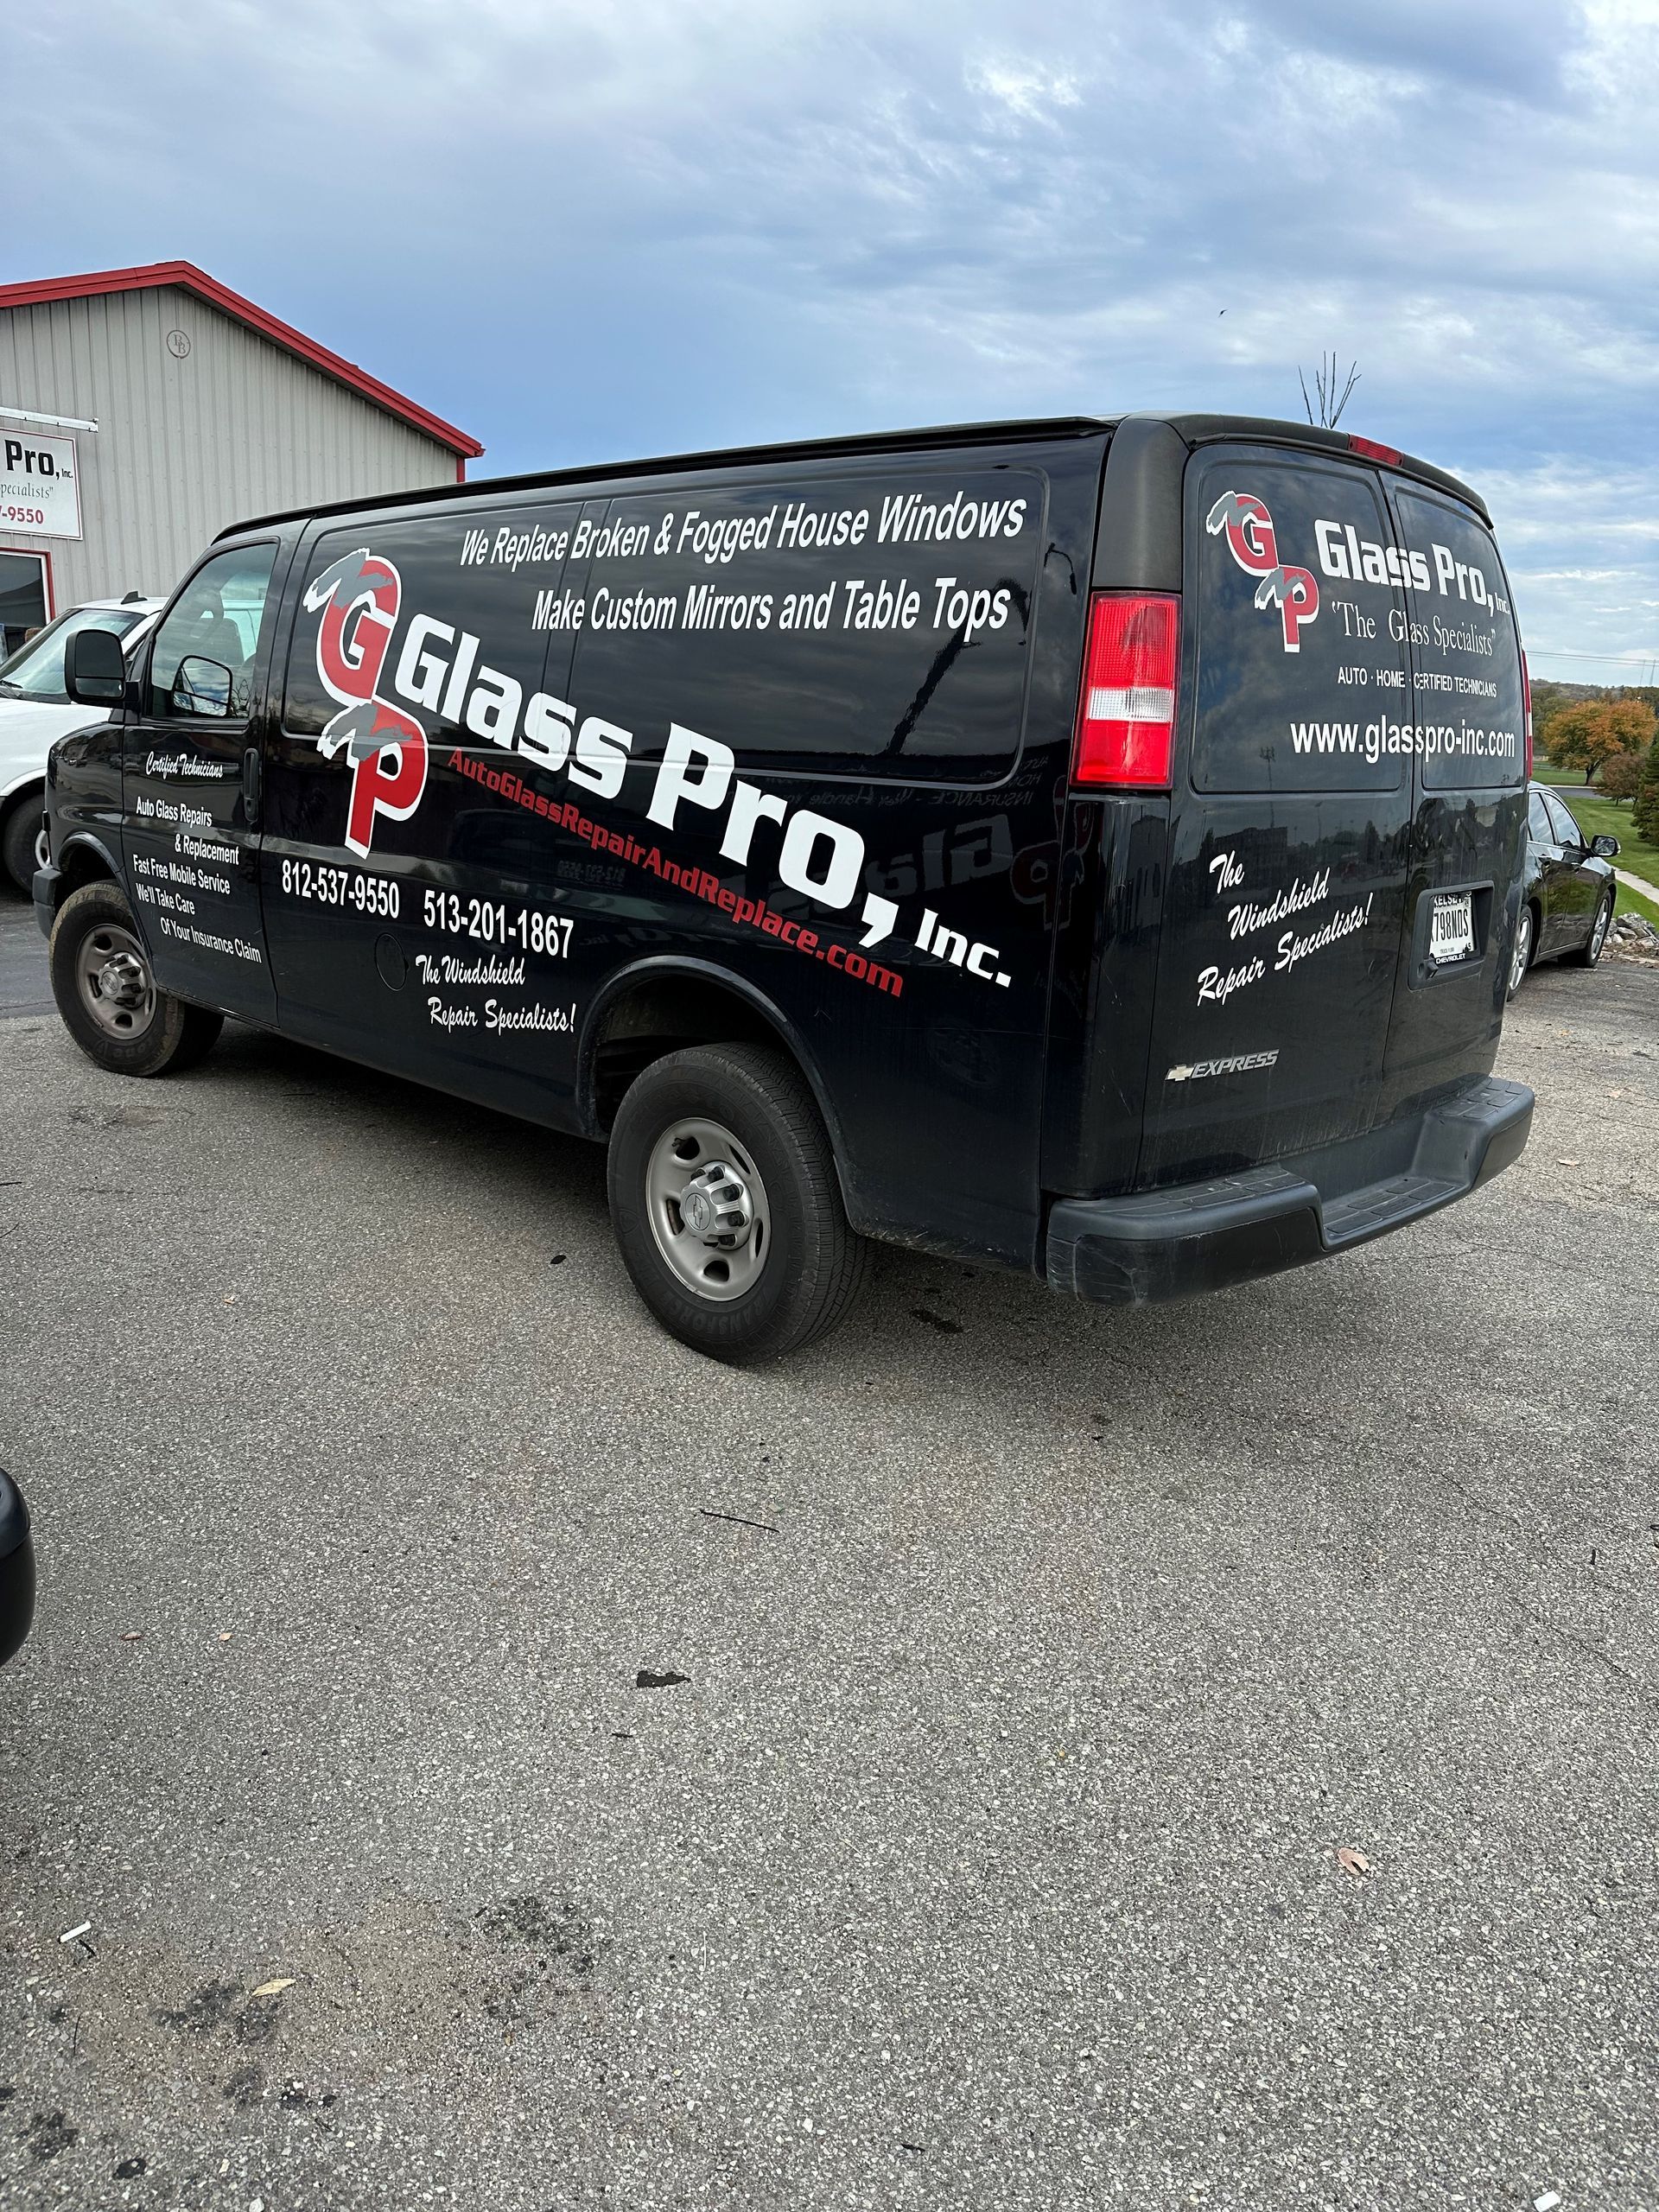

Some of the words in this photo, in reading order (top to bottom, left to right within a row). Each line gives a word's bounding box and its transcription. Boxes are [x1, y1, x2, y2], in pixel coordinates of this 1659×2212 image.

[4, 439, 60, 480] Pro,
[61, 467, 73, 478] Inc.
[0, 482, 54, 499] pecialists"
[0, 505, 44, 524] -9550
[460, 528, 488, 566] We
[490, 524, 569, 572] Replace
[570, 517, 650, 559] Broken
[653, 512, 674, 555] &
[676, 505, 778, 564] Fogged
[777, 502, 869, 549] House
[877, 491, 1027, 543] Windows
[1314, 518, 1431, 592] Glass
[1431, 543, 1494, 617] Pro,
[1496, 592, 1510, 615] Inc.
[531, 588, 585, 630] Make
[590, 587, 677, 630] Custom
[681, 584, 773, 630] Mirrors
[779, 581, 836, 630] and
[842, 578, 921, 630] Table
[932, 577, 1011, 643] Tops
[1389, 608, 1429, 645] Glass
[1338, 666, 1367, 685] AUTO
[1376, 669, 1406, 688] HOME
[1414, 671, 1453, 692] CERTIFIED
[1454, 676, 1497, 698] TECHNICIANS
[1290, 715, 1516, 764] www.glasspro-inc.com
[145, 751, 180, 779] Certified
[179, 753, 224, 778] Technicians
[137, 796, 155, 817] Auto
[156, 799, 179, 822] Glass
[180, 803, 213, 829] Repairs
[394, 613, 633, 799] Glass
[645, 721, 899, 948] Pro,
[914, 908, 1012, 988] Inc.
[175, 833, 181, 852] &
[183, 835, 239, 865] Replacement
[133, 854, 151, 875] Fast
[150, 858, 168, 879] Free
[169, 861, 197, 887] Mobile
[197, 868, 231, 895] Service
[282, 859, 399, 918] 812-537-9550
[448, 747, 904, 997] AutoGlassRepairAndReplace.com
[1209, 849, 1245, 894] The
[136, 883, 156, 905] We'll
[155, 887, 175, 909] Take
[175, 893, 195, 915] Care
[1227, 867, 1331, 941] Windshield
[160, 917, 172, 936] Of
[171, 919, 190, 940] Your
[190, 925, 234, 955] Insurance
[234, 938, 263, 963] Claim
[423, 890, 575, 959] 513-201-1867
[415, 955, 441, 985] The
[442, 954, 525, 985] Windshield
[1197, 956, 1266, 1007] Repair
[1274, 892, 1374, 973] Specialists!
[1435, 952, 1466, 964] CHEVROLET
[428, 996, 478, 1033] Repair
[485, 999, 576, 1036] Specialists!
[1192, 1048, 1280, 1079] EXPRESS
